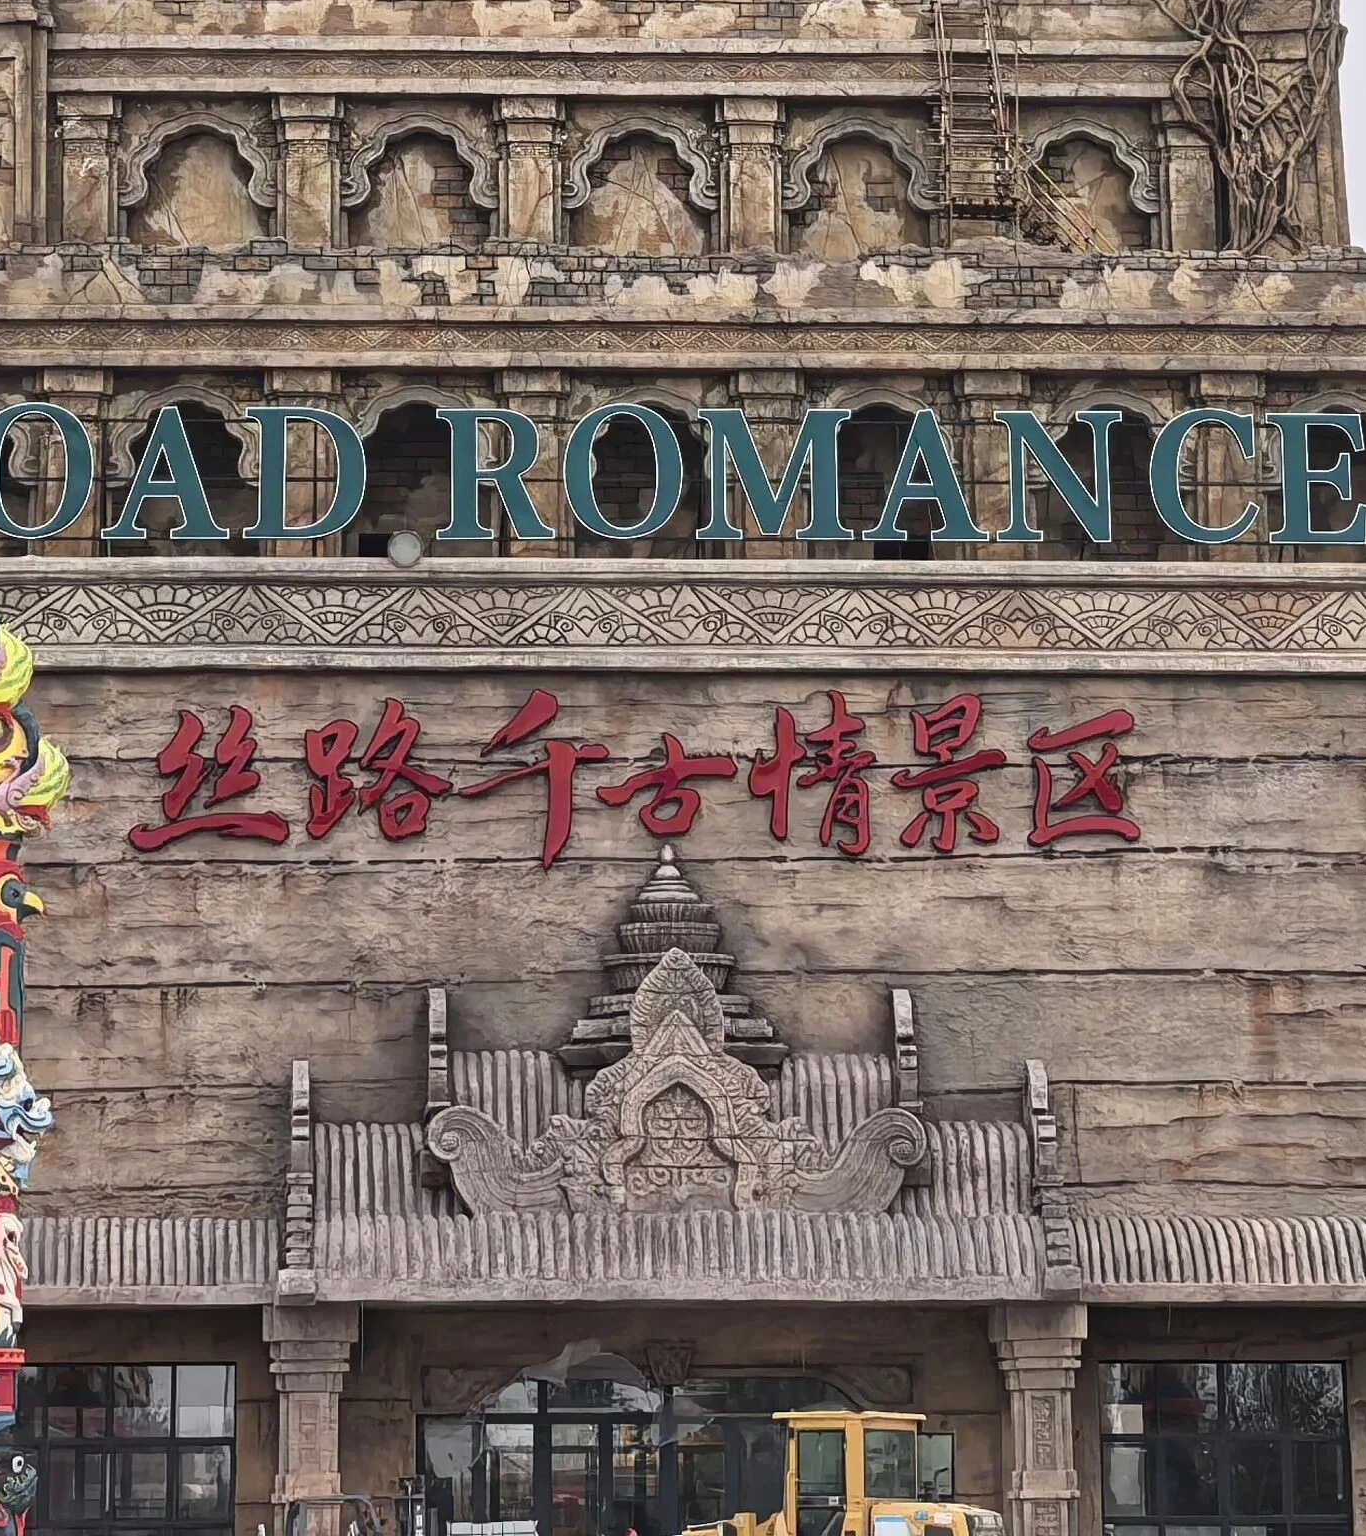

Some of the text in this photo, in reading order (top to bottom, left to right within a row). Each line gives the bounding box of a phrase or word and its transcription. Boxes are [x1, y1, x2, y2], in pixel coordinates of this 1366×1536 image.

[128, 688, 1142, 866] 丝路千古情景区
